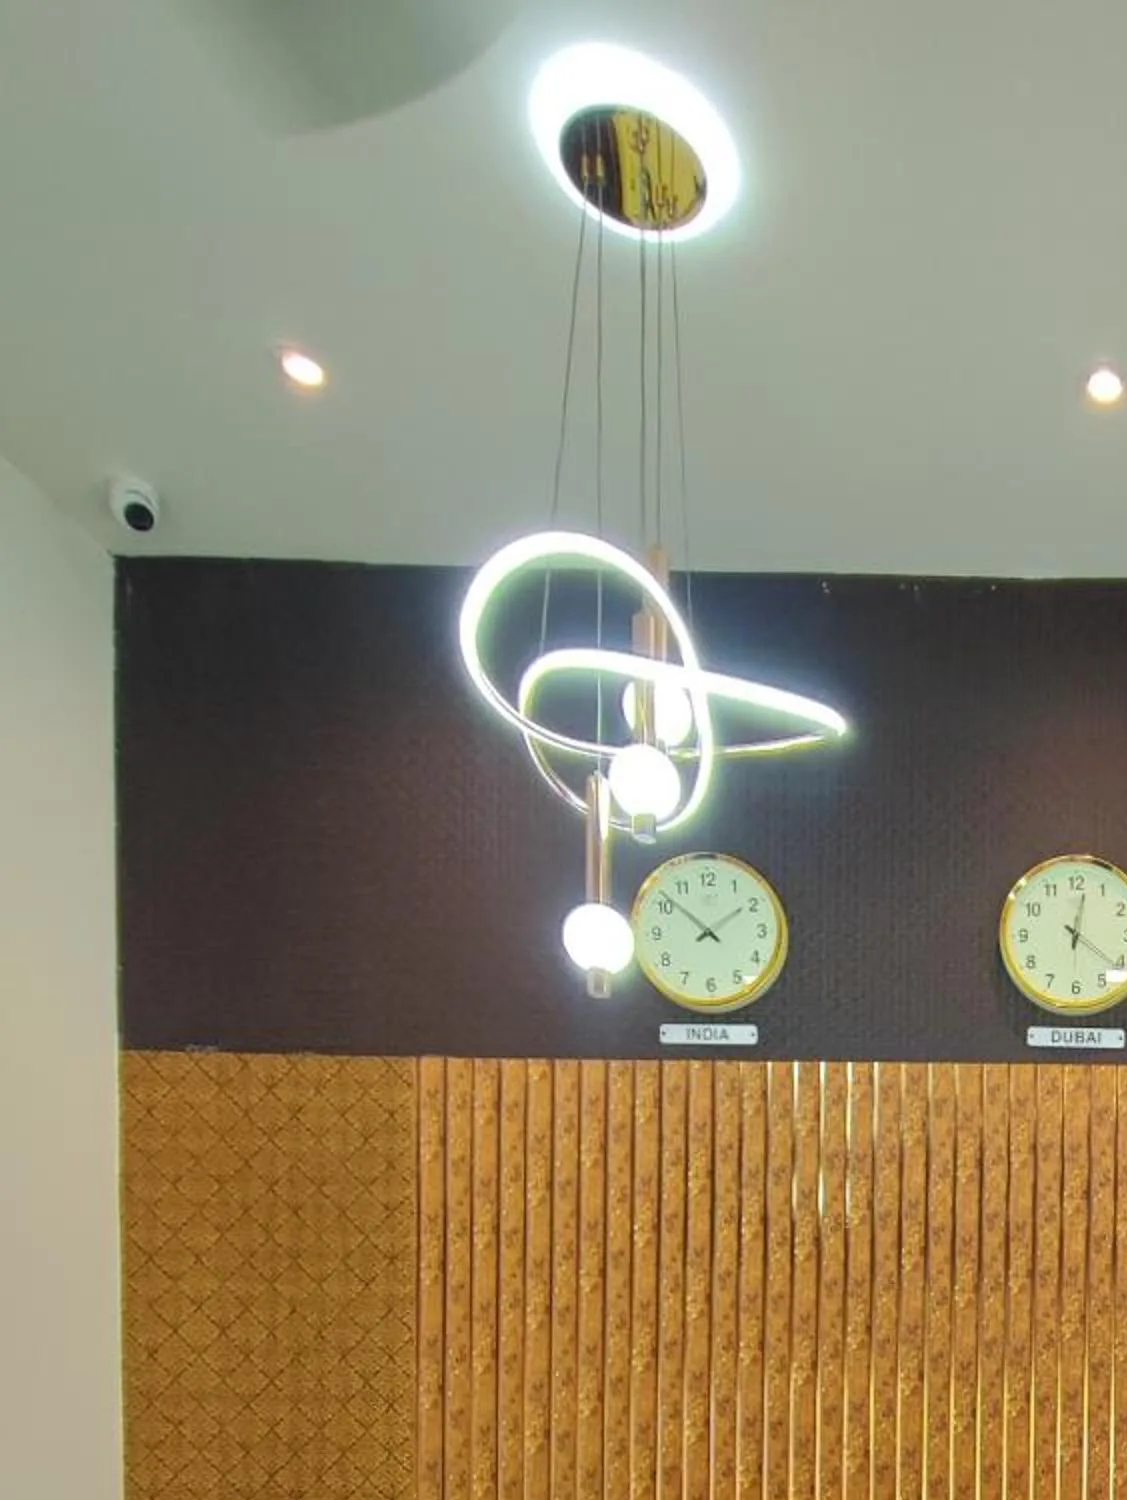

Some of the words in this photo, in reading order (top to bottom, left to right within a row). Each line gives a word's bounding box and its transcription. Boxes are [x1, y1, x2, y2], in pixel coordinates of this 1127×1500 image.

[701, 872, 716, 886] 12
[1069, 876, 1085, 890] 12
[676, 881, 689, 894] 11
[732, 880, 737, 893] 1
[1044, 884, 1057, 896] 11
[1101, 885, 1105, 896] 1
[658, 899, 673, 914] 10
[750, 898, 759, 912] 2
[1027, 903, 1041, 917] 10
[1116, 903, 1125, 916] 2
[652, 927, 661, 940] 9
[758, 924, 767, 938] 3
[1019, 929, 1028, 942] 9
[661, 953, 670, 966] 8
[751, 951, 760, 964] 4
[1026, 955, 1036, 968] 8
[1114, 954, 1125, 966] 4
[680, 972, 689, 985] 7
[733, 970, 742, 984] 5
[1045, 974, 1054, 987] 7
[1098, 974, 1107, 987] 5
[706, 978, 716, 992] 6
[1072, 981, 1081, 994] 6
[686, 1028, 729, 1040] INDIA
[1051, 1031, 1102, 1044] DUBAI
